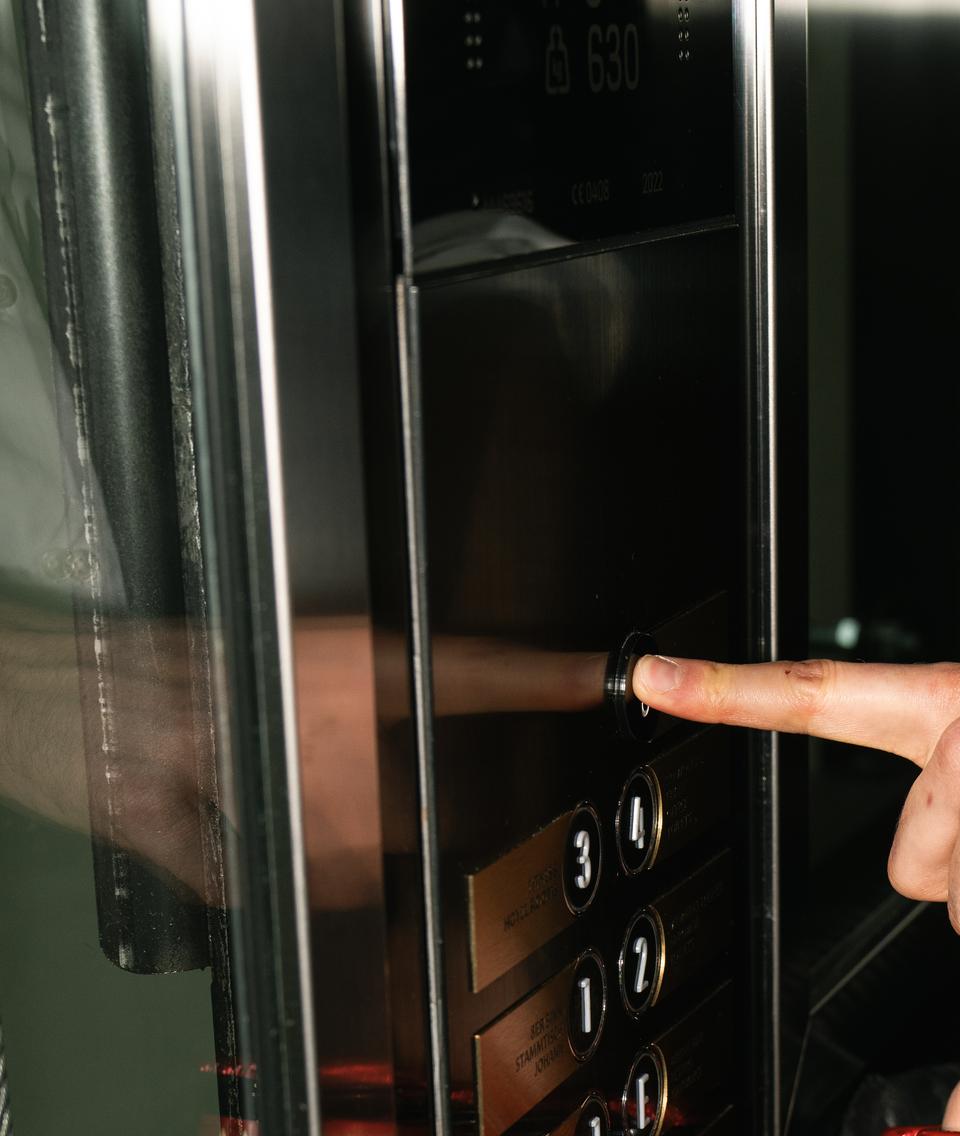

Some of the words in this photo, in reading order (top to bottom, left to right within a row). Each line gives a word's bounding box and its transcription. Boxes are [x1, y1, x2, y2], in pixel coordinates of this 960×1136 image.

[588, 23, 639, 93] 630
[641, 170, 664, 195] 2022
[628, 796, 646, 849] 4
[573, 830, 592, 888] 3
[633, 937, 649, 993] 2
[579, 978, 592, 1033] 1
[637, 1073, 651, 1129] E
